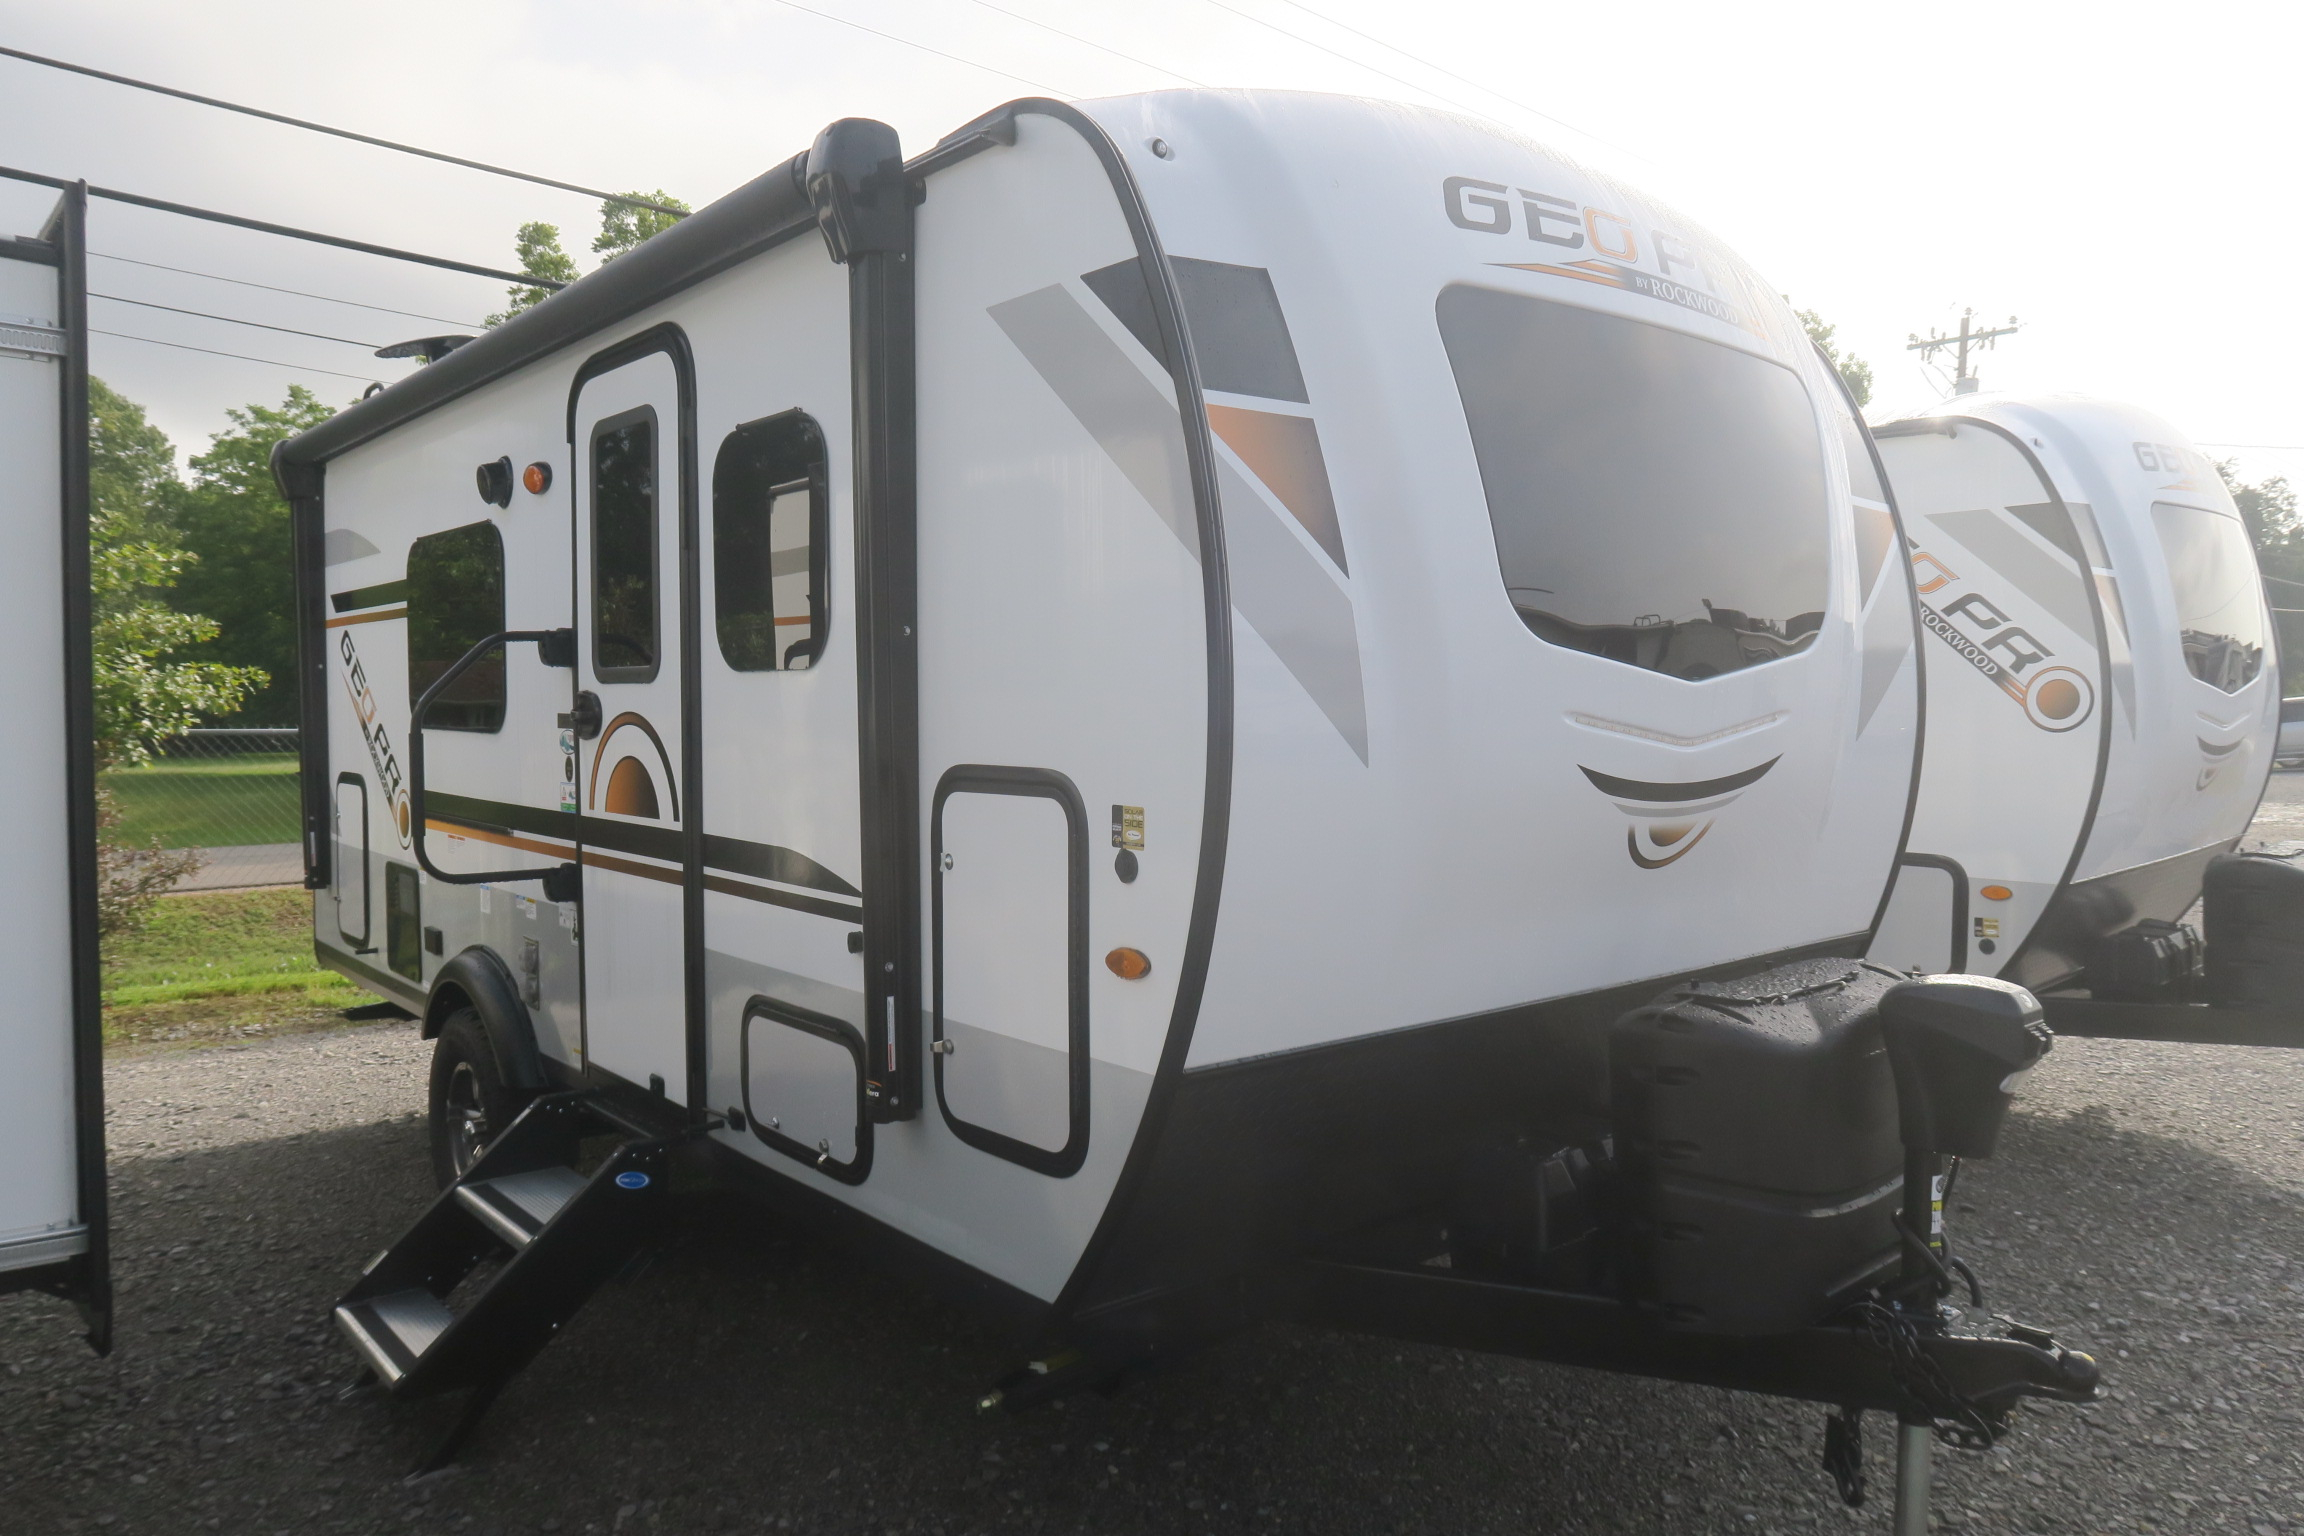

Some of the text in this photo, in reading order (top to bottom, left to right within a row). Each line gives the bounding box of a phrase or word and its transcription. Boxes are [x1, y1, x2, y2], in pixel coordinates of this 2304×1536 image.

[1442, 175, 1638, 264] GEO
[1635, 275, 1739, 325] BY ROCKWOOD
[1920, 606, 1999, 676] ROCKWOOD
[340, 629, 378, 725] GEO
[1124, 819, 1143, 828] SIDE
